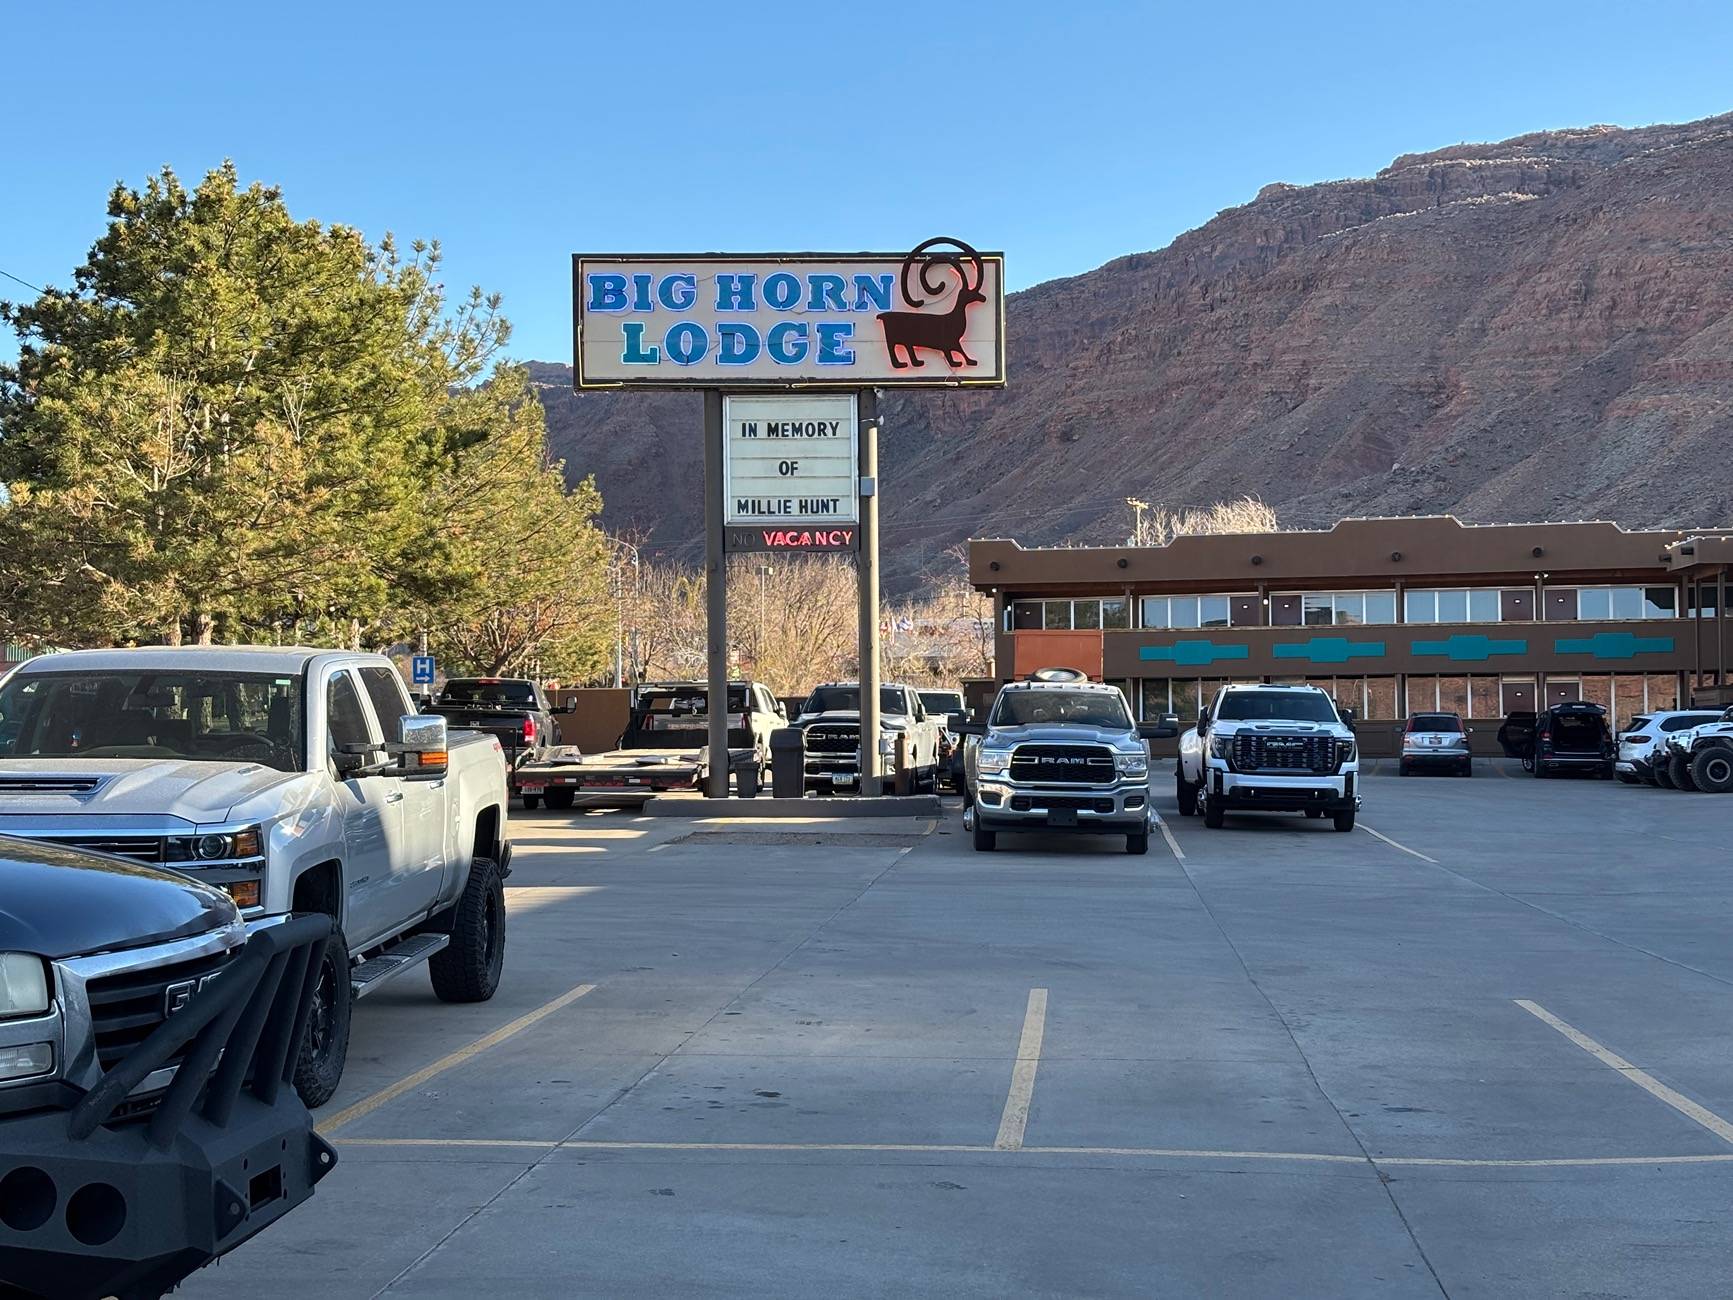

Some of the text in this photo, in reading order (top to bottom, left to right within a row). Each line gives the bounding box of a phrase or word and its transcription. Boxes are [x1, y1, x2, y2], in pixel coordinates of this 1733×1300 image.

[587, 271, 896, 312] BIG HORN
[621, 320, 855, 366] LODGE
[741, 421, 840, 438] IN MEMORY
[778, 460, 799, 476] OF
[737, 499, 840, 515] MILLIE HUNT
[733, 530, 853, 546] NO VACANCY
[416, 659, 430, 674] H
[1041, 757, 1085, 765] RAM
